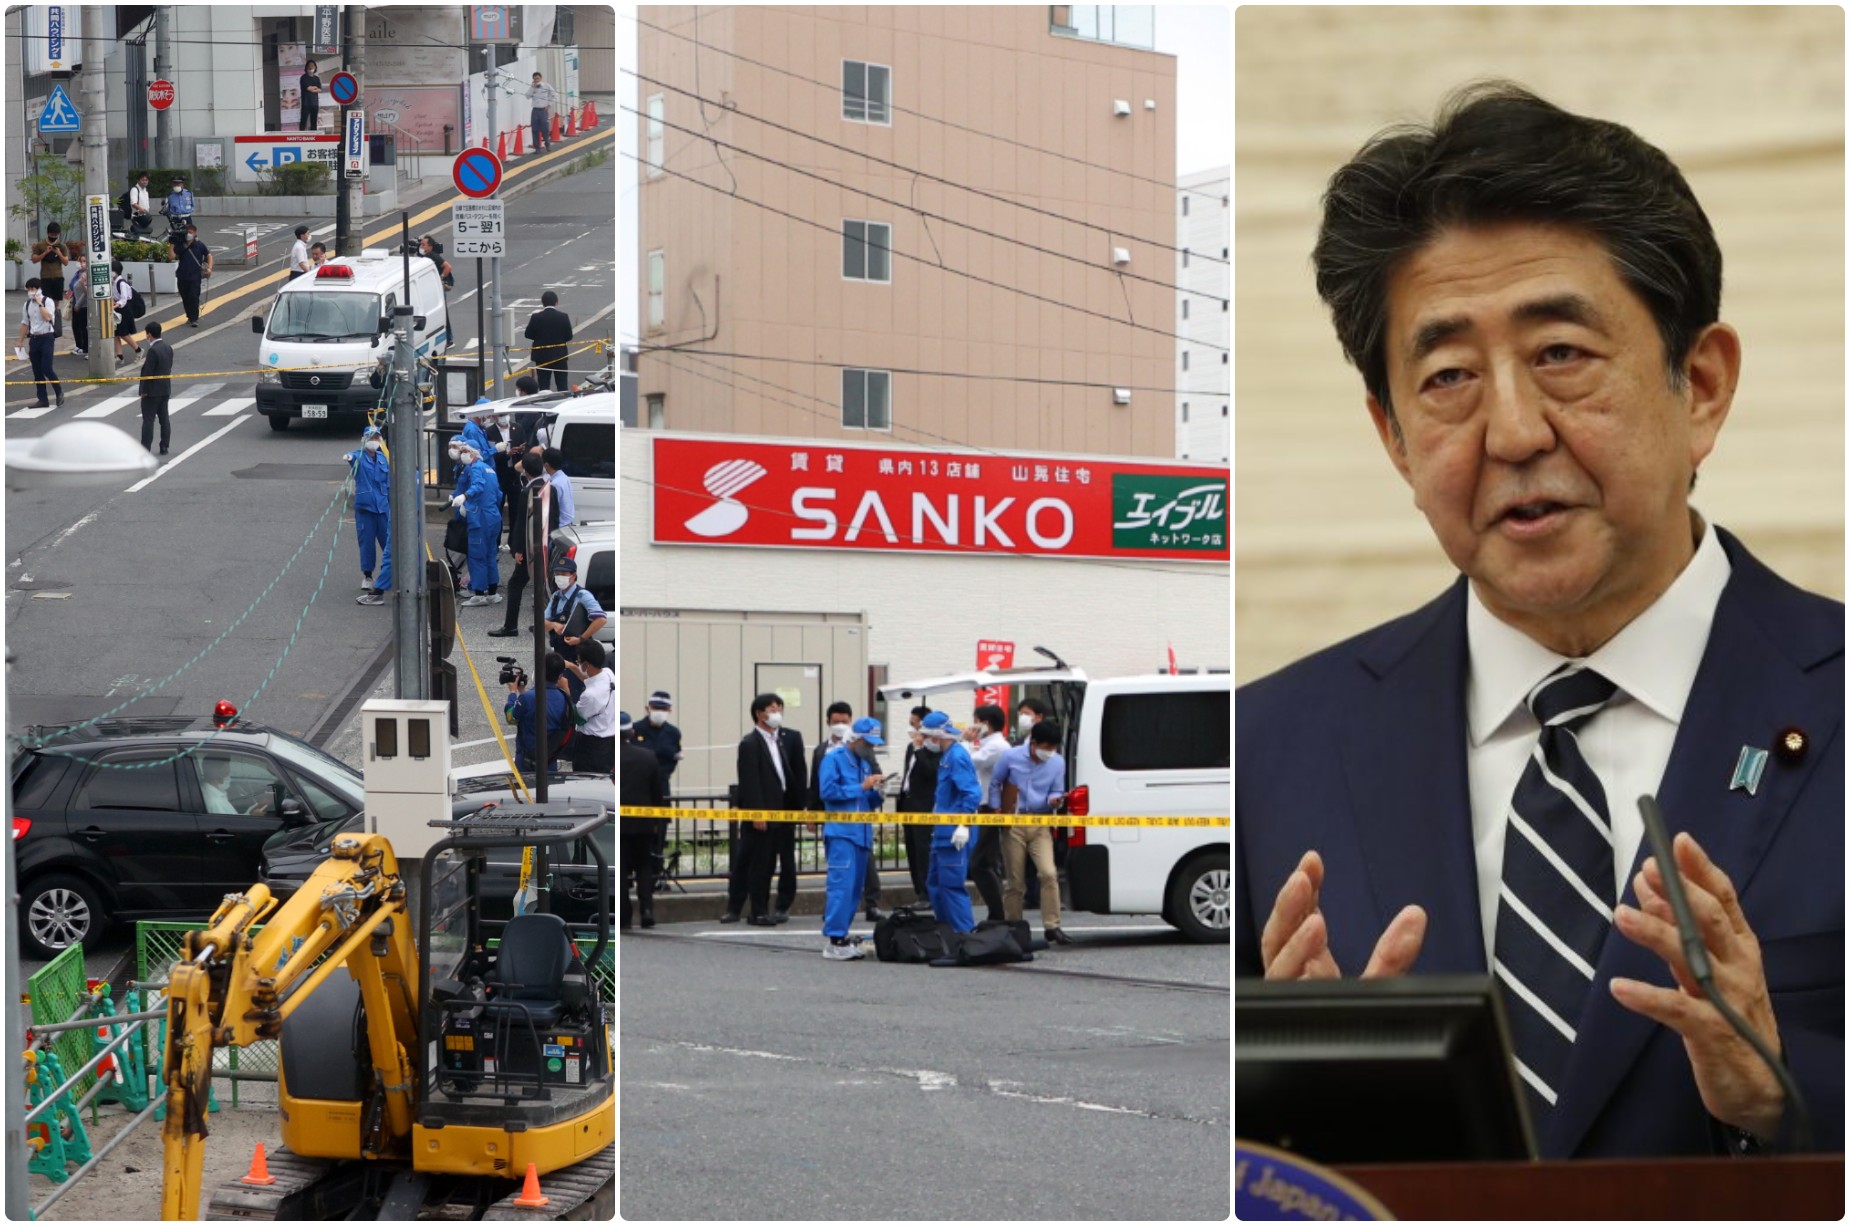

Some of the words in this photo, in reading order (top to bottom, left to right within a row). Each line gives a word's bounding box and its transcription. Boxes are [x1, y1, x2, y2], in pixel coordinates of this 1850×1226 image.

[369, 21, 396, 39] aile
[377, 112, 397, 123] mary
[456, 242, 502, 253] ここから
[790, 451, 844, 473] 賃貸
[1011, 464, 1092, 484] 山晃住宅
[790, 486, 1074, 549] SANKO
[1121, 488, 1225, 530] エイブル
[1149, 531, 1223, 546] ネットワーク店
[1249, 1167, 1339, 1220] Japan
